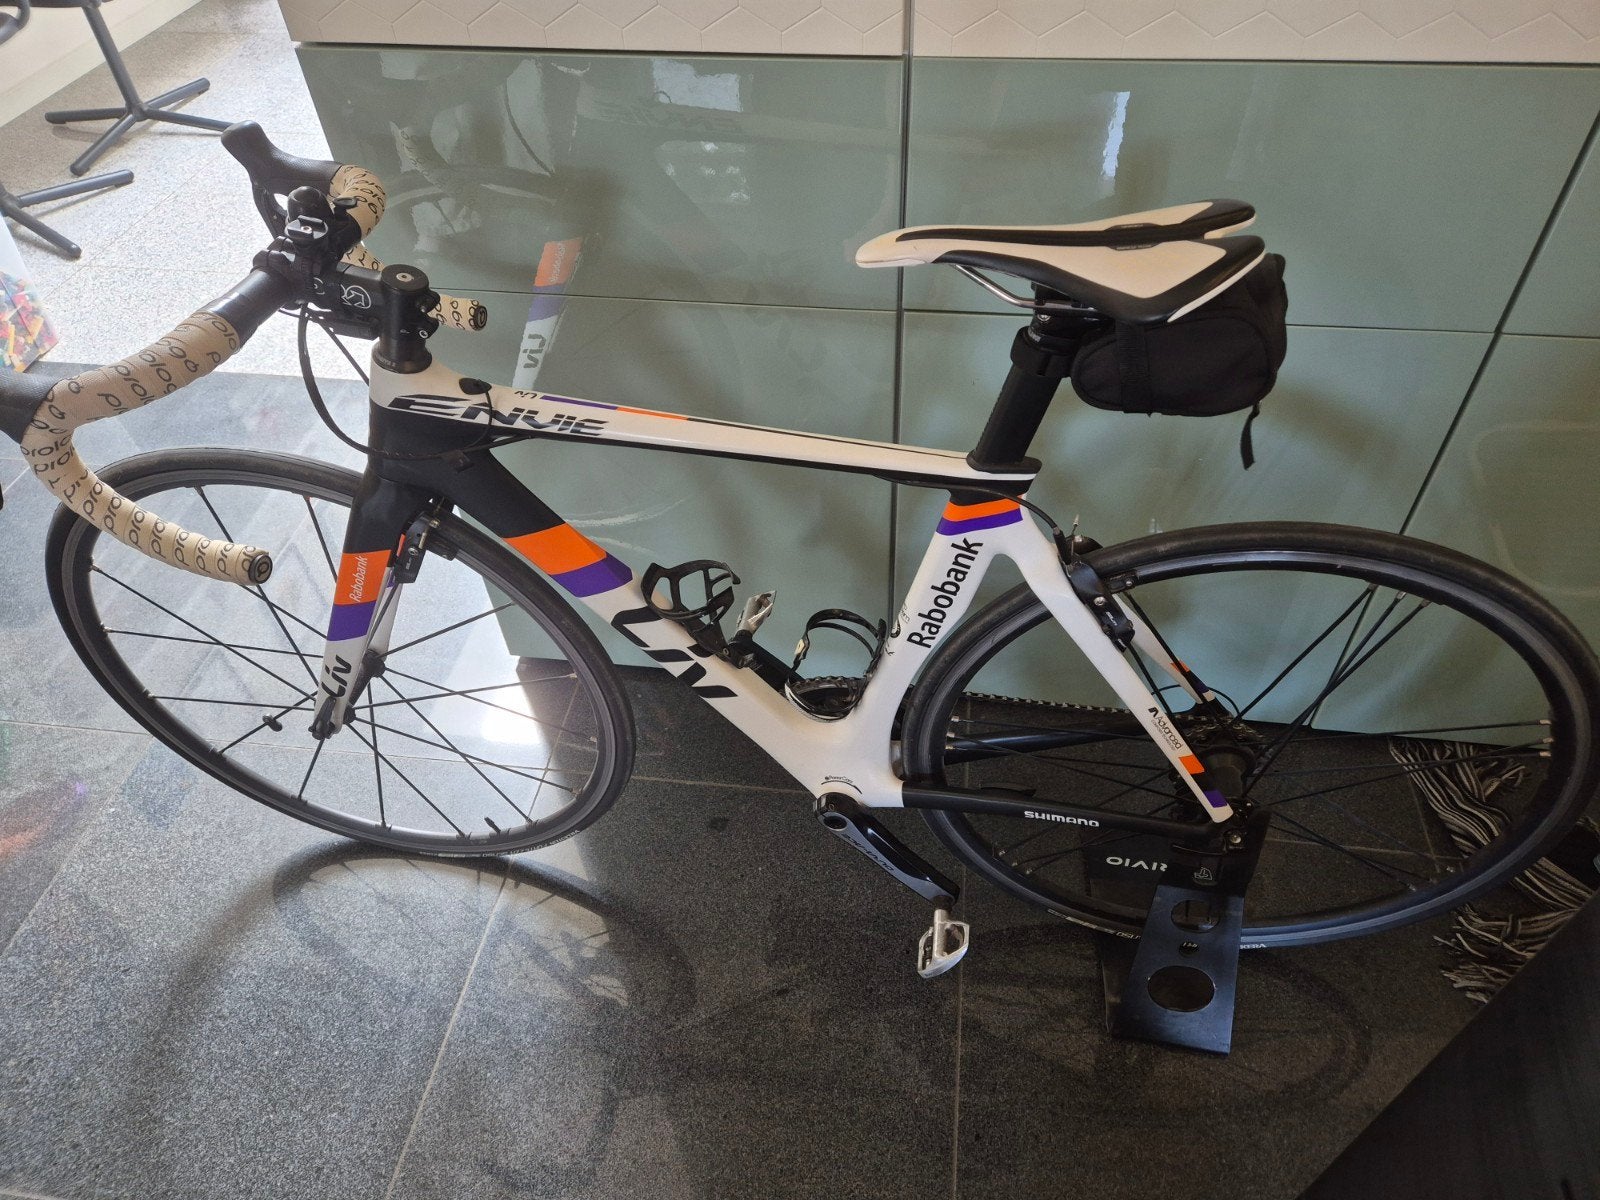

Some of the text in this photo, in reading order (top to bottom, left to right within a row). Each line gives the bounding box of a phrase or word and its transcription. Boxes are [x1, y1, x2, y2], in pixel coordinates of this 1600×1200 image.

[349, 555, 368, 603] Rabobank
[906, 537, 984, 649] Rabobank
[321, 654, 352, 698] Liv
[1024, 810, 1100, 828] SHIMANO
